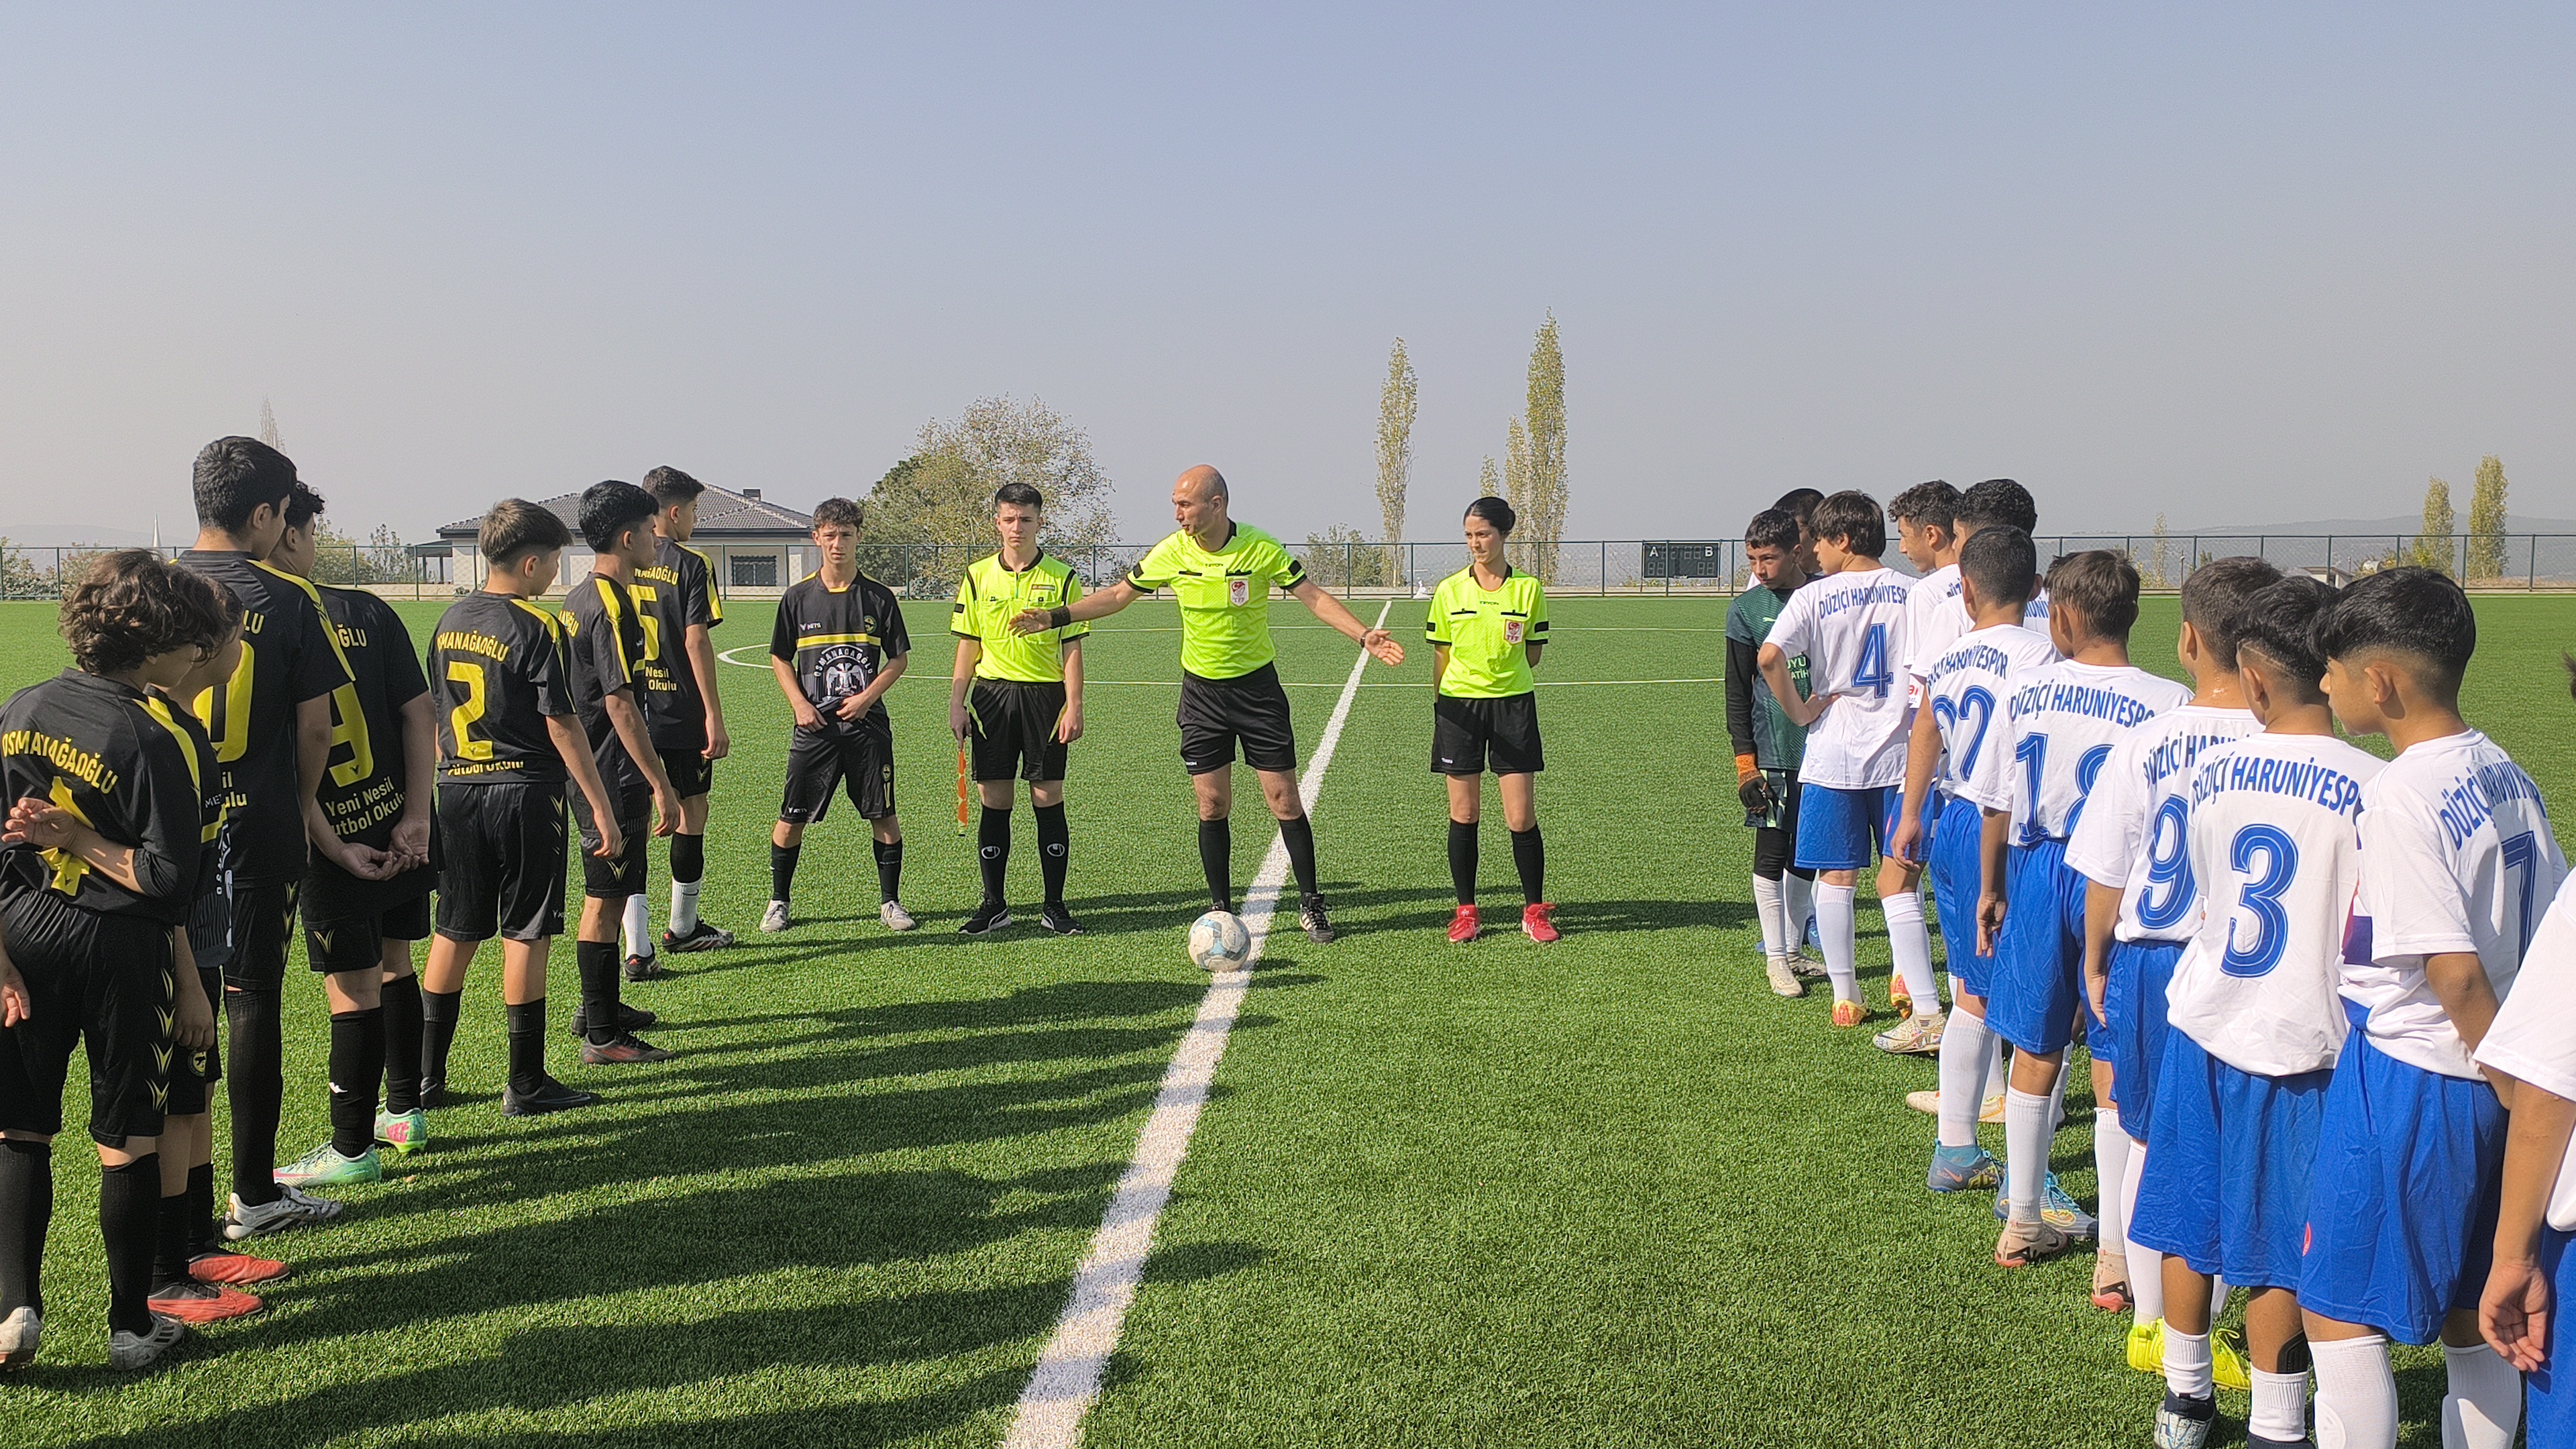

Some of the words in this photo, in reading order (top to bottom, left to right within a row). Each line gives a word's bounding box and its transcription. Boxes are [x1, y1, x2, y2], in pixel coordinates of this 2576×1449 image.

[1649, 547, 1659, 557] A
[1705, 547, 1713, 557] B
[627, 584, 659, 661] 5
[1819, 586, 1850, 619] DÜZİÇİ
[1851, 582, 1907, 606] HARUNİYESP
[645, 666, 669, 679] Nesil
[648, 679, 678, 691] Okulu
[1851, 623, 1894, 699] 4
[447, 661, 494, 761] 2
[2010, 679, 2055, 722] DÜZİÇİ
[2051, 684, 2155, 728] HARUNİYESP
[325, 793, 361, 816] Yeni
[362, 776, 394, 806] Nesil
[2230, 757, 2359, 816] HARUNİYESP
[2440, 767, 2497, 851] DÜZİÇİ
[331, 811, 372, 836] utbol
[2136, 794, 2197, 929] 9
[2220, 823, 2298, 977] 3
[2500, 830, 2538, 969] 7
